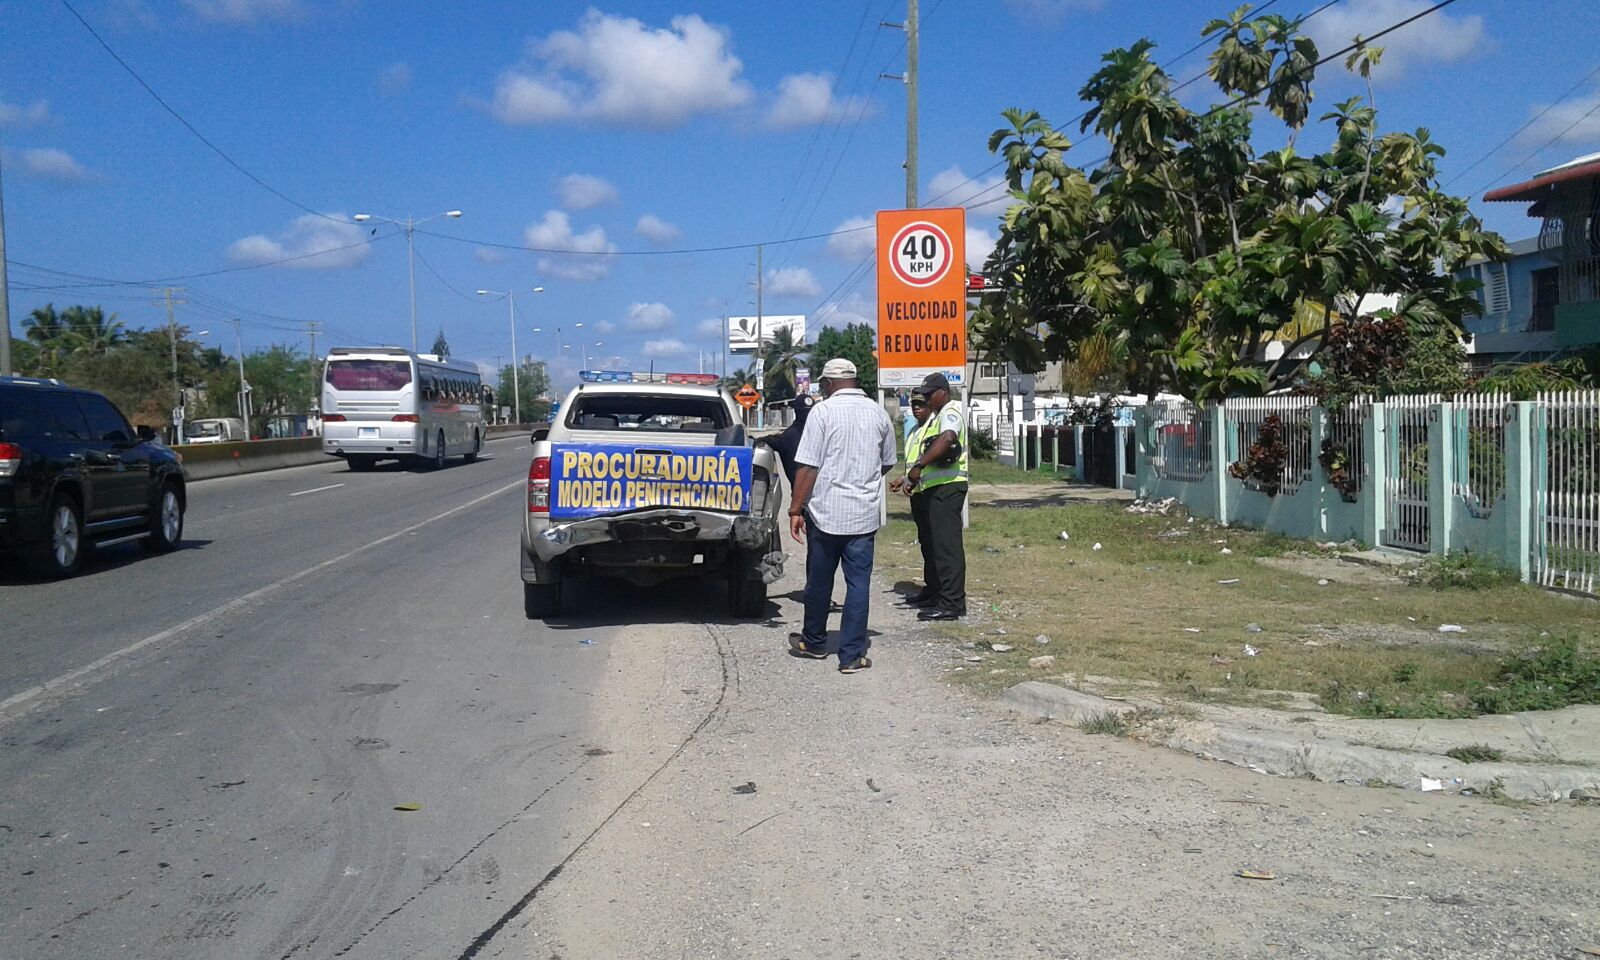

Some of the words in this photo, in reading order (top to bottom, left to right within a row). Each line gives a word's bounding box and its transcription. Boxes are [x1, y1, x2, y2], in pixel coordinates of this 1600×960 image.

[902, 235, 936, 260] 40
[910, 262, 933, 273] KPH
[886, 301, 957, 321] VELOCIDAD
[884, 333, 960, 353] REDUCIDA
[562, 451, 741, 482] PROCURADURÍA
[558, 480, 621, 508] MODELO
[625, 483, 742, 511] PENITENCIARIO
